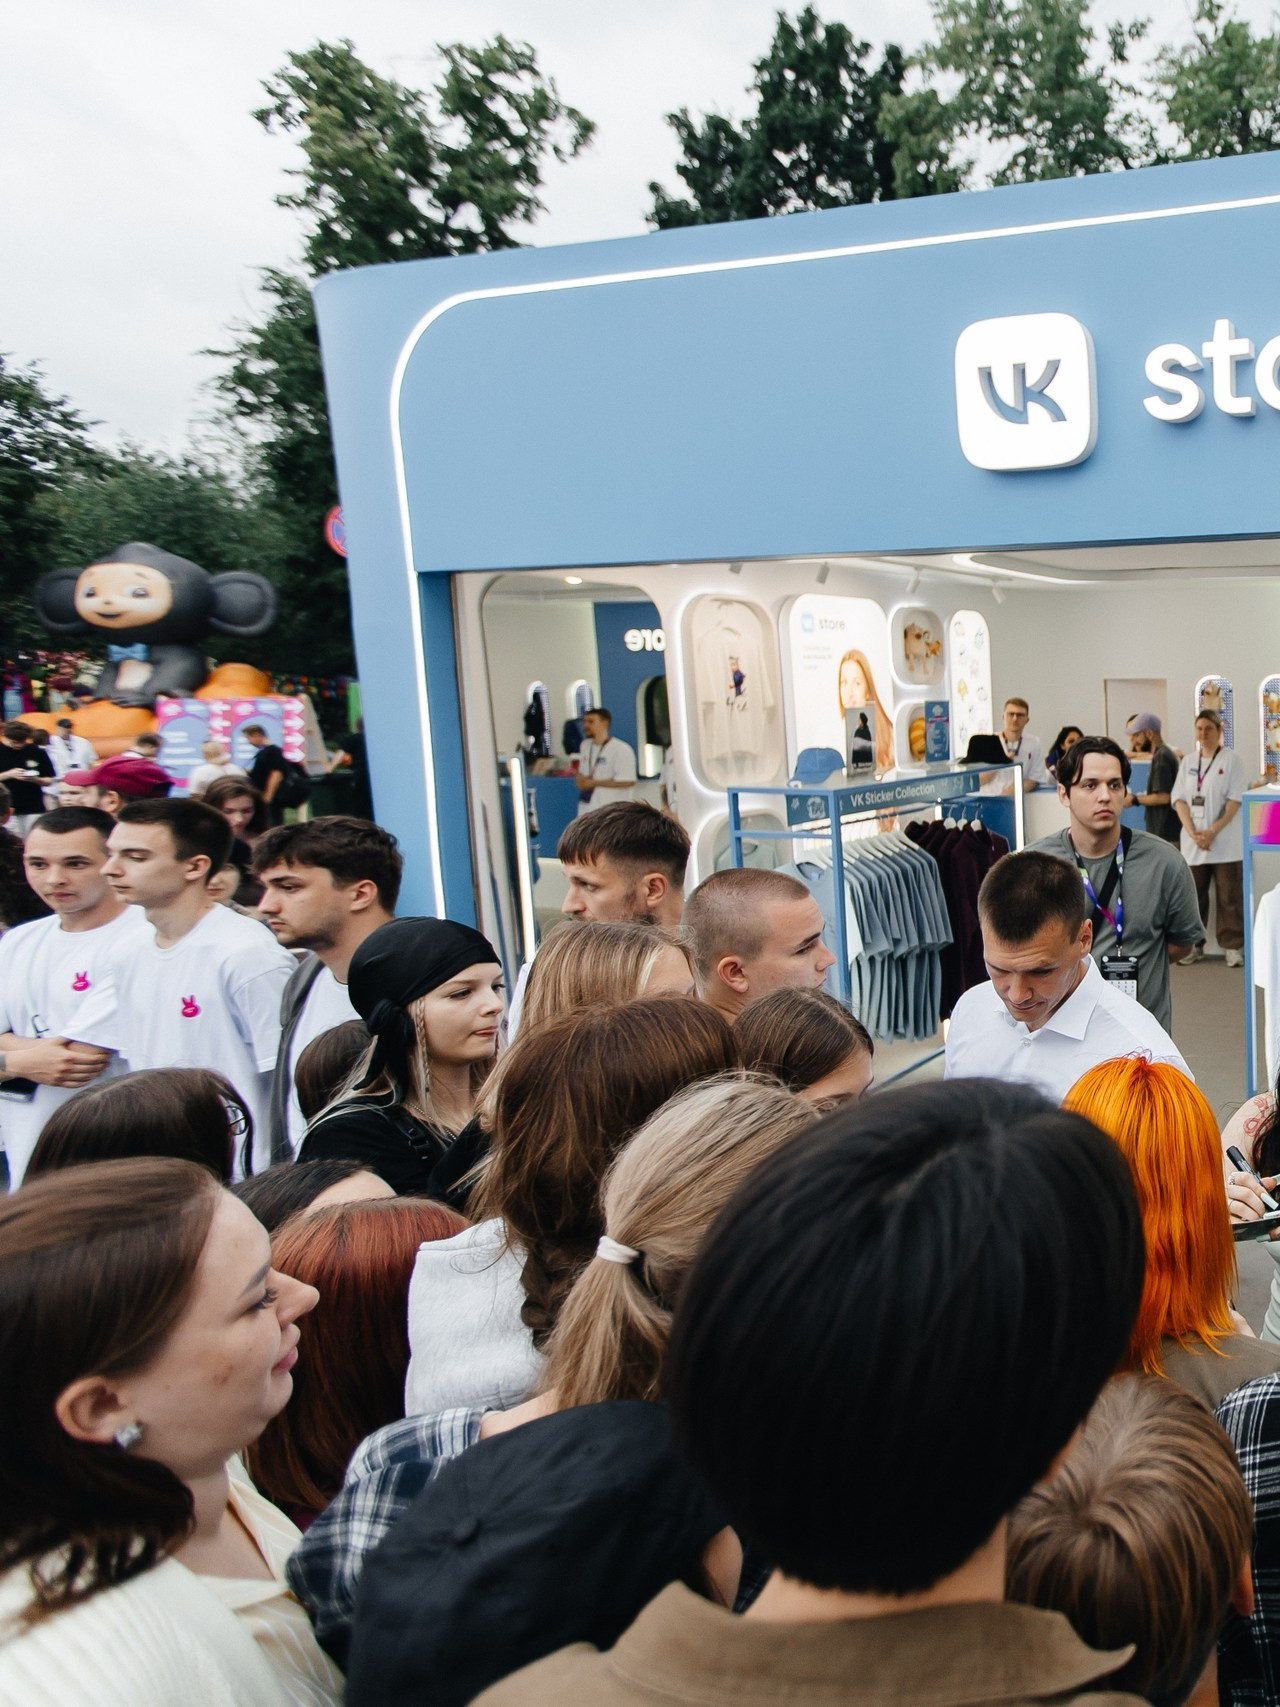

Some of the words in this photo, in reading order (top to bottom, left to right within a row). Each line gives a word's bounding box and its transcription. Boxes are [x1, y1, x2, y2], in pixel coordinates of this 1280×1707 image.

[976, 358, 1068, 425] VK
[817, 616, 847, 632] store
[850, 793, 865, 808] VK
[865, 790, 895, 805] Sticker
[895, 783, 936, 800] Collection
